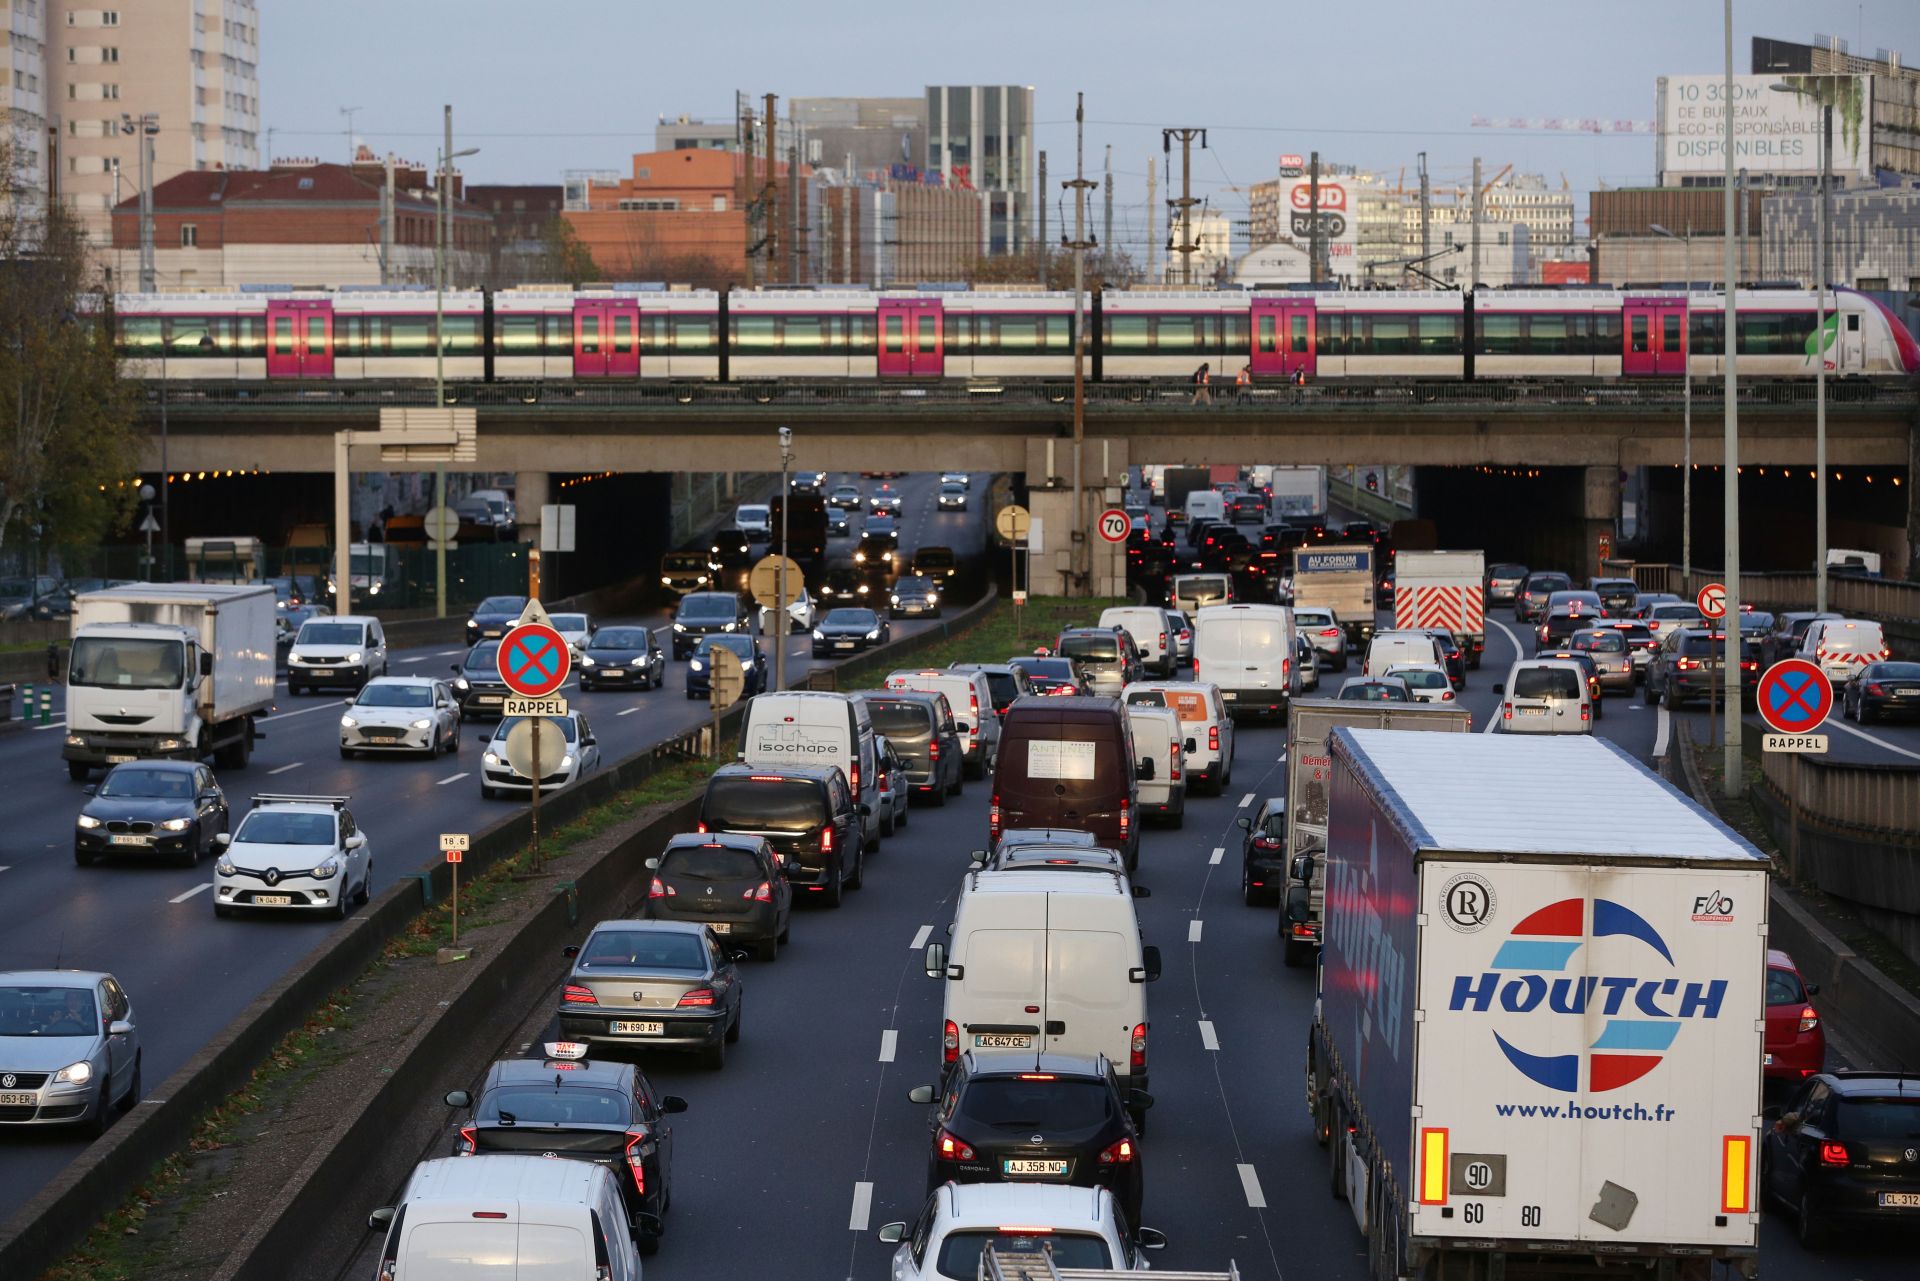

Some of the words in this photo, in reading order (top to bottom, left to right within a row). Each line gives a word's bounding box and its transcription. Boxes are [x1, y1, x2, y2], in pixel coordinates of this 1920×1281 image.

[1678, 84, 1699, 100] 10
[1678, 106, 1696, 119] DE
[1678, 122, 1825, 136] ECO-RSPONSABLES
[1280, 156, 1302, 166] SUD
[1105, 519, 1124, 533] 70
[1323, 555, 1357, 563] FORUM
[508, 701, 563, 714] RAPPEL
[758, 743, 838, 754] isochape
[1769, 737, 1822, 749] RAPPEL
[1314, 769, 1322, 780] &
[1448, 972, 1729, 1019] HOUTCH
[1495, 1100, 1675, 1122] www.houtch.fr
[1468, 1164, 1488, 1187] 90
[1464, 1202, 1484, 1224] 60
[1521, 1205, 1541, 1228] 80
